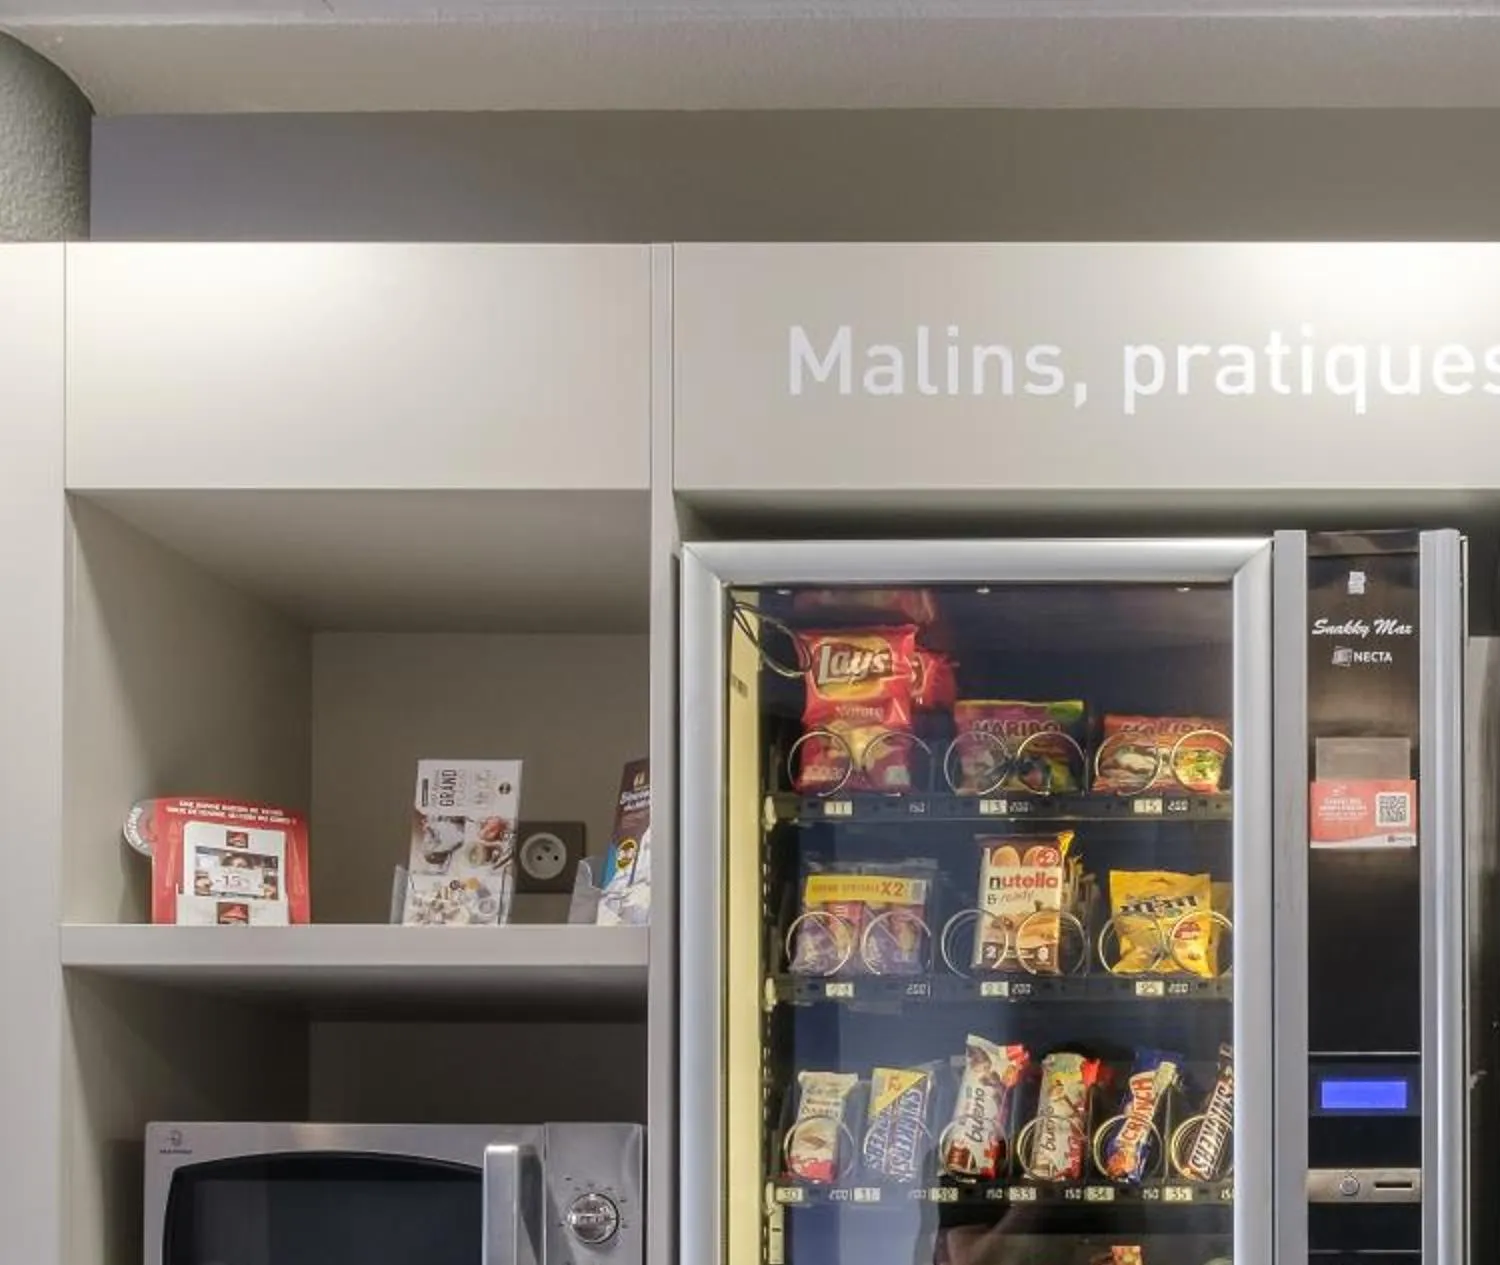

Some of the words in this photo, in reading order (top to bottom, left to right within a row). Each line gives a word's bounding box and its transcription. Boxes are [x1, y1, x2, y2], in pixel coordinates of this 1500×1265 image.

[788, 324, 1088, 409] Malins,
[817, 645, 891, 685] Lay's
[1353, 651, 1393, 663] NECTA
[439, 769, 457, 807] GRAND
[990, 872, 1058, 889] nutella
[966, 1087, 986, 1143] bueno
[1122, 1080, 1153, 1140] CRUNCH
